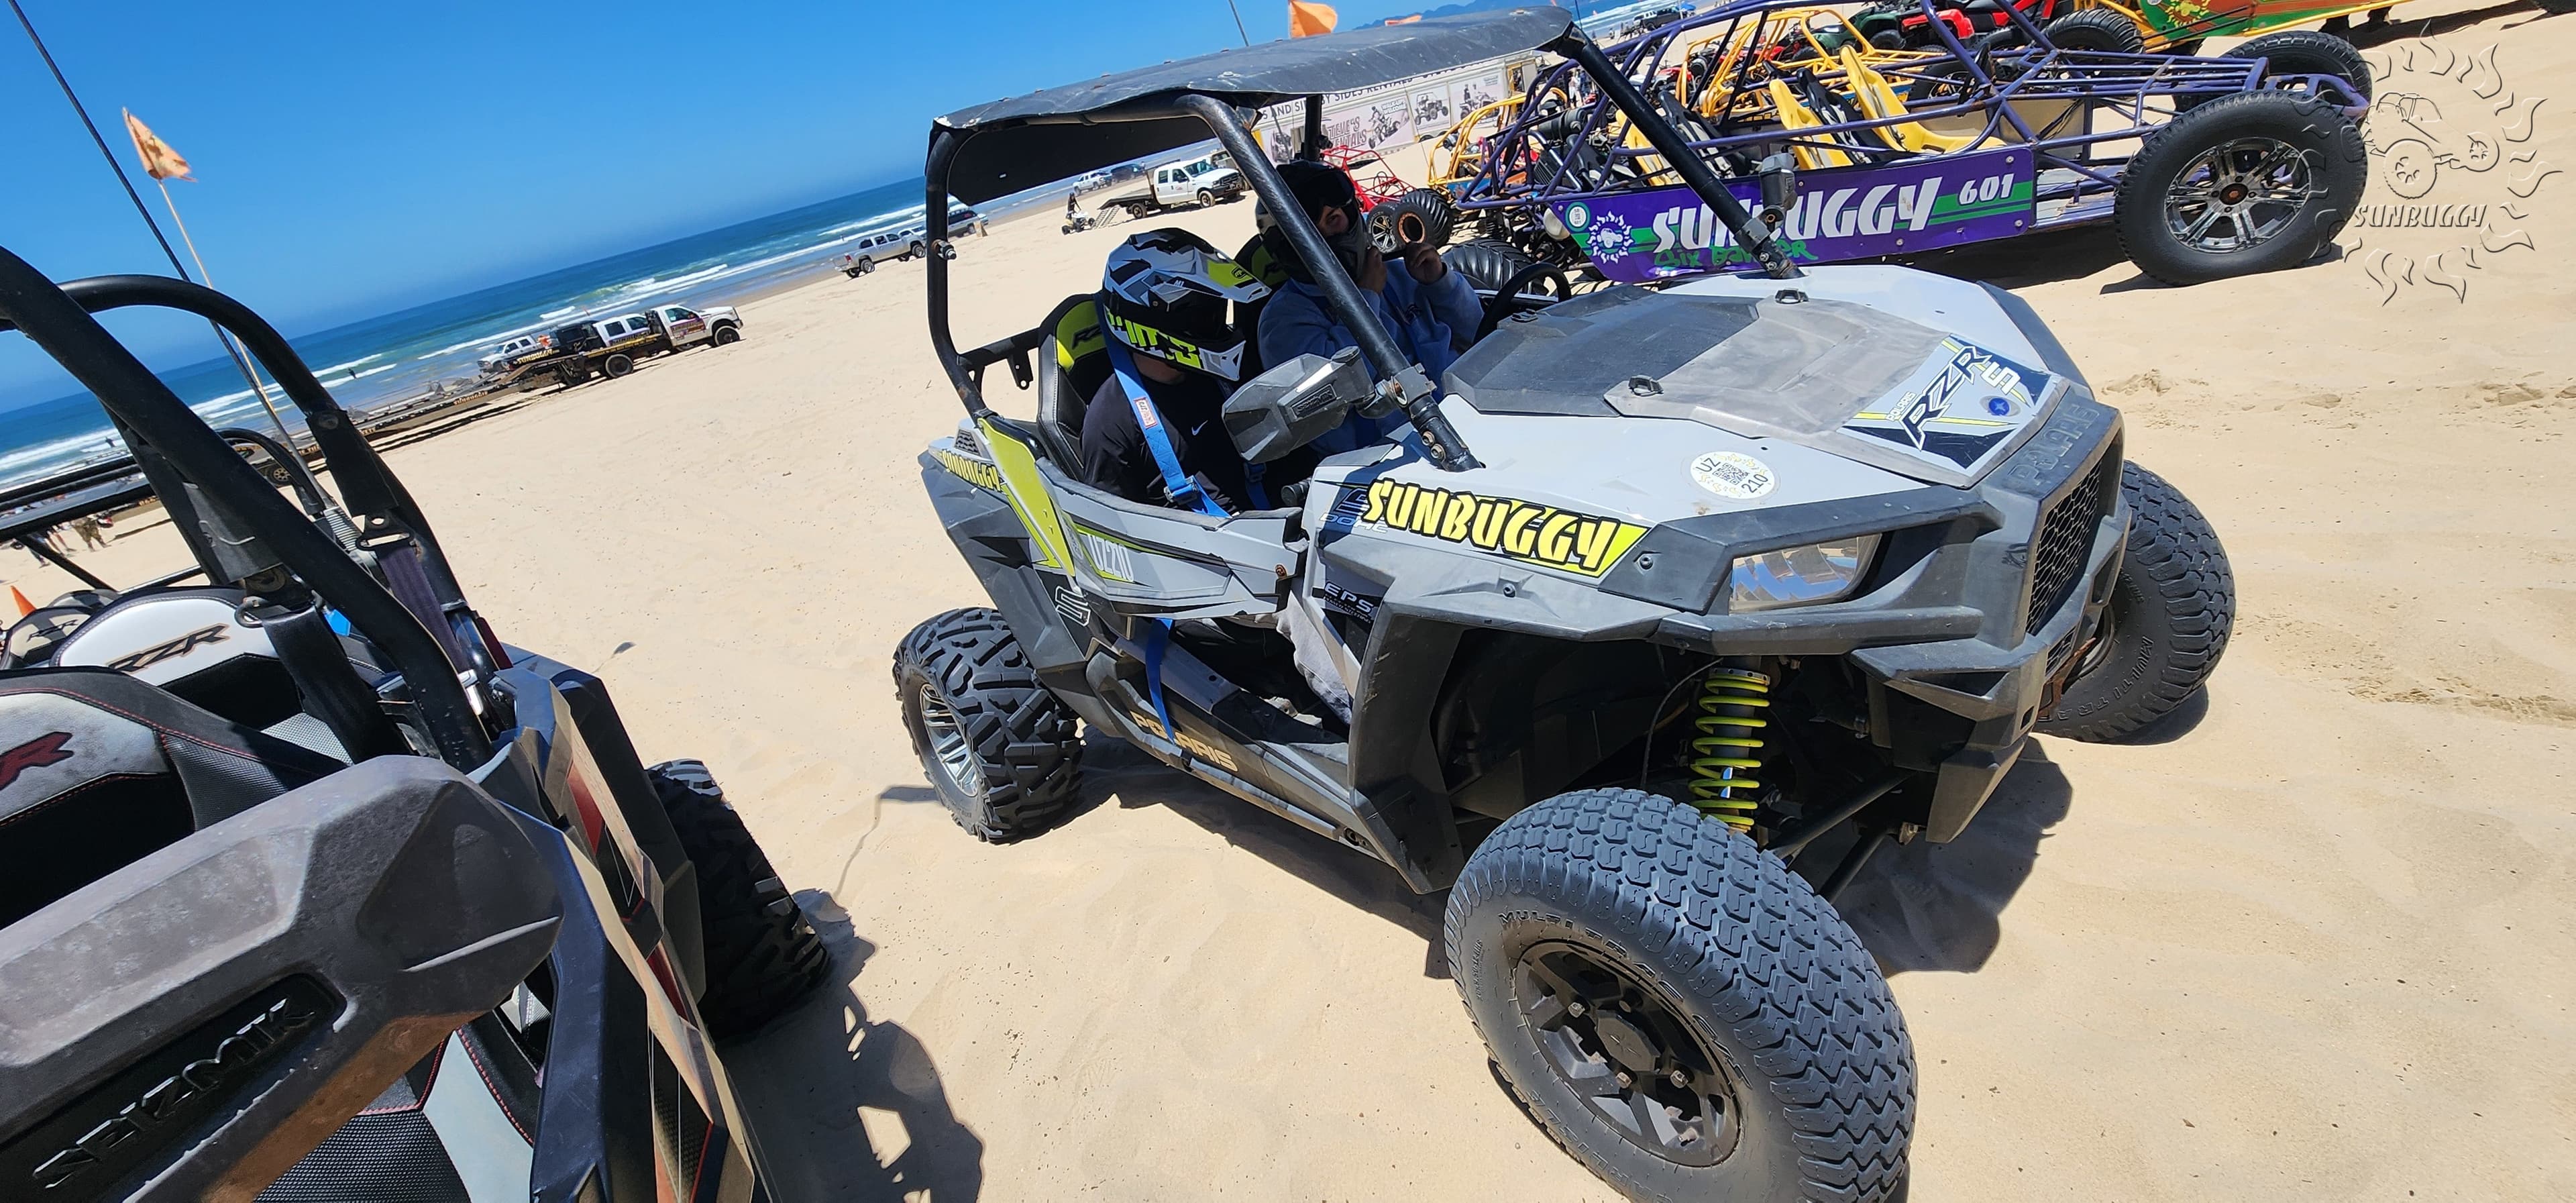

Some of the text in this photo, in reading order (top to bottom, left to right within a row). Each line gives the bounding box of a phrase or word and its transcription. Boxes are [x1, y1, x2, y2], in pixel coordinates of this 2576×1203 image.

[1272, 105, 1291, 118] AND
[1334, 85, 1363, 101] SIDES
[1328, 116, 1360, 139] TEVE'S
[1333, 129, 1367, 147] ENTALS
[1652, 173, 2015, 254] SUNUGGY 601
[1886, 390, 1917, 421] POLARIS
[1898, 346, 1992, 452] RZR
[2007, 403, 2100, 486] POLARIS
[1695, 457, 1721, 472] UZ
[1741, 474, 1769, 493] 210
[1319, 512, 1389, 534] DOHC
[1362, 478, 1618, 570] SUNBUGGY
[1324, 582, 1375, 613] EPS
[105, 623, 231, 674] RZR
[2111, 635, 2155, 698] MULTI
[1497, 910, 1574, 930] MULTI
